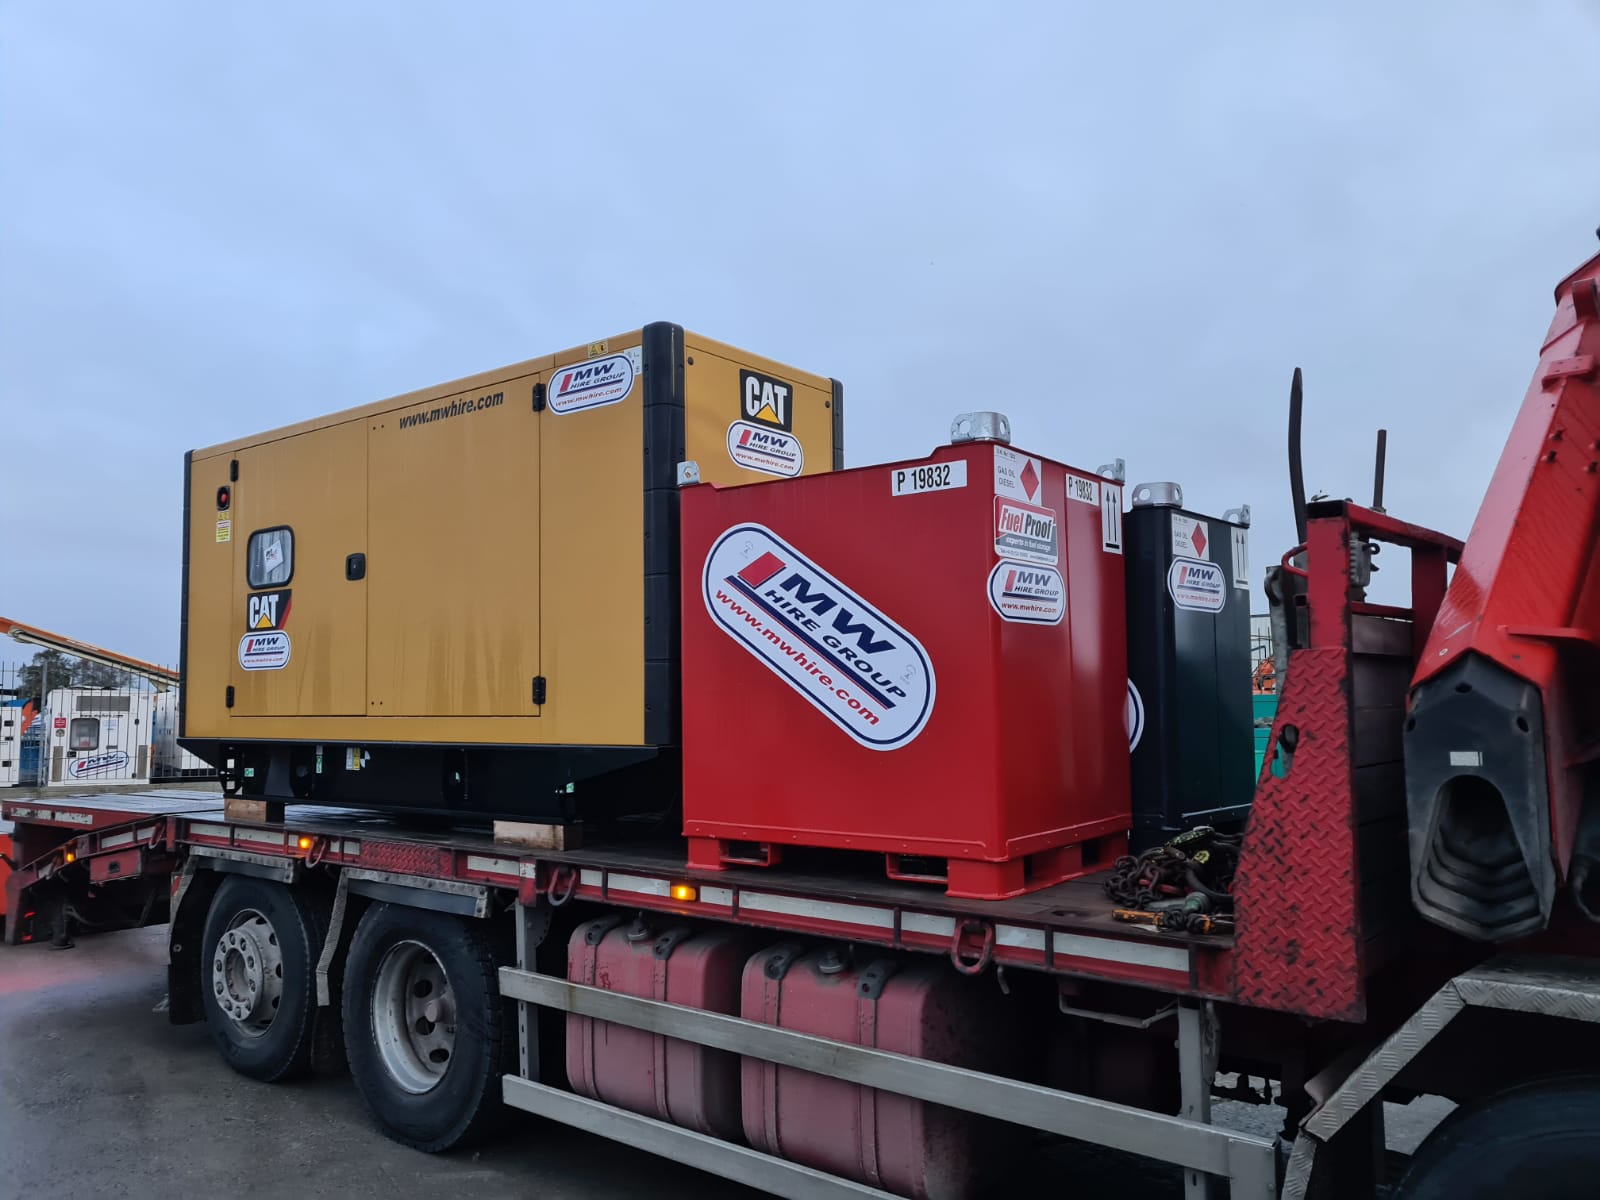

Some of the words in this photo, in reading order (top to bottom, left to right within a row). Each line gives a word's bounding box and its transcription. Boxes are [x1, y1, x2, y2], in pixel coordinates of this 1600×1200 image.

[570, 379, 590, 389] HIRE
[593, 371, 625, 384] GROUP
[573, 362, 615, 382] MW
[399, 391, 504, 429] www.mwhire.com
[745, 376, 788, 425] CAT
[749, 442, 768, 451] HIRE
[770, 447, 796, 457] GROUP
[752, 432, 788, 448] MW
[897, 471, 906, 492] P
[911, 464, 951, 490] 19832
[1075, 479, 1093, 501] 19832
[1001, 508, 1024, 533] Fuel
[1024, 514, 1053, 540] Proof
[1017, 571, 1051, 586] MW
[1188, 567, 1214, 580] MW
[1015, 585, 1033, 594] HIRE
[1034, 588, 1059, 597] GROUP
[249, 594, 279, 629] CAT
[779, 572, 896, 654] MW
[1001, 603, 1057, 614] www.mwhire.com
[255, 637, 279, 646] MW
[764, 589, 821, 632] HIRE
[822, 635, 907, 698] GROUP
[715, 589, 880, 726] www.mwhire.com
